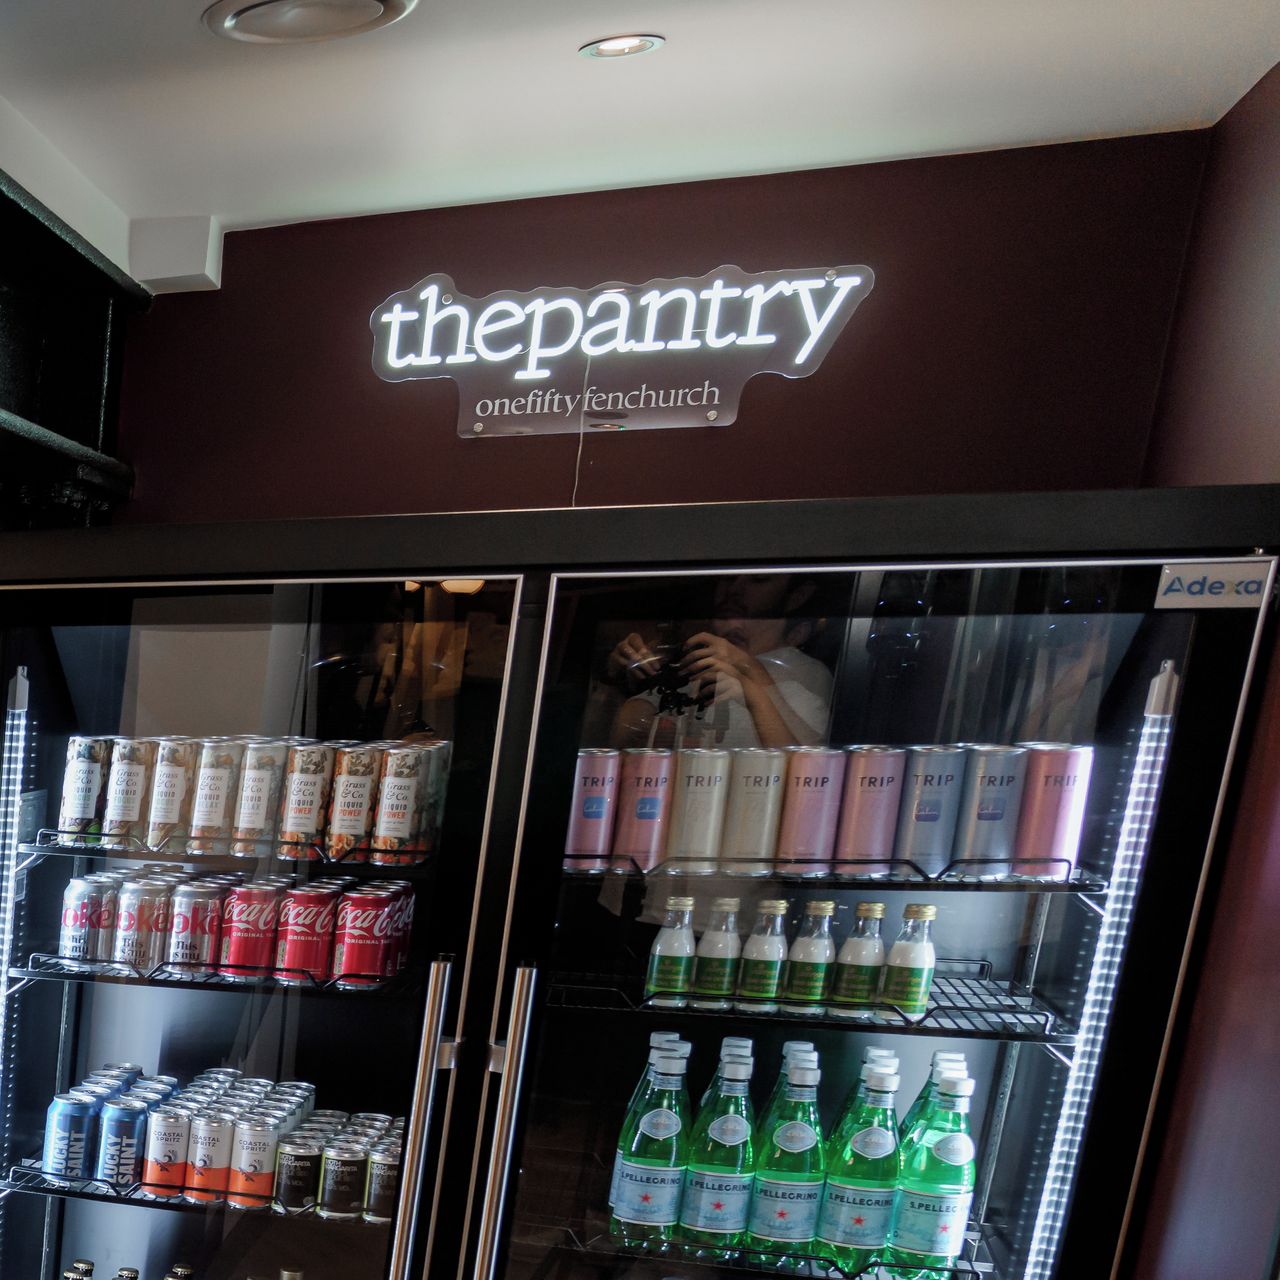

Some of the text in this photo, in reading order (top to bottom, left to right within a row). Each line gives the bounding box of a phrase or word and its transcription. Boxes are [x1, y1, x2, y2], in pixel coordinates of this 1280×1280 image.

[381, 276, 862, 380] thepantry
[475, 380, 721, 418] onefiftyfenchurch
[1162, 575, 1263, 596] Adexa
[582, 776, 615, 787] TRIP
[635, 776, 668, 788] TRIP
[686, 775, 723, 788] TRIP
[743, 775, 780, 788] TRIP
[794, 776, 831, 788] TRIP
[859, 775, 895, 788] TRIP
[913, 774, 954, 787] TRIP
[977, 775, 1016, 787] TRIP
[157, 789, 176, 798] IQUID
[291, 799, 314, 807] LIQUID
[340, 801, 363, 809] LIQUID
[290, 806, 312, 816] POWER
[339, 808, 362, 818] POWER
[62, 900, 113, 930] oke
[117, 904, 168, 933] oke
[223, 894, 277, 930] Coca-C
[278, 897, 335, 934] Coca-C
[336, 900, 392, 937] Coca-C
[168, 906, 220, 935] oke
[345, 937, 379, 945] ORIGINAL
[103, 1133, 122, 1185] LUCKY
[117, 1135, 138, 1185] SAINT
[909, 1201, 958, 1213] S.PELLEG
